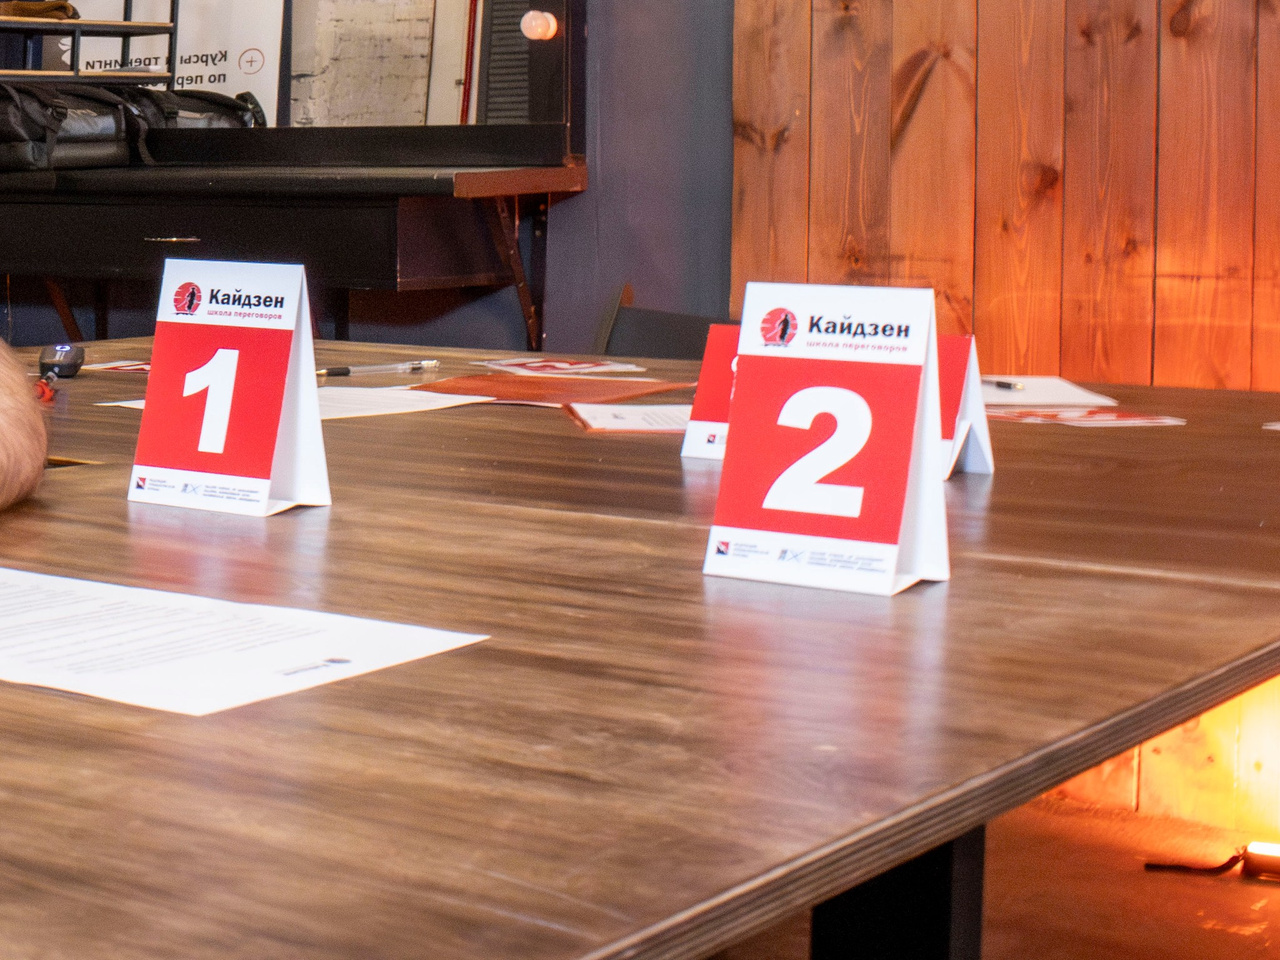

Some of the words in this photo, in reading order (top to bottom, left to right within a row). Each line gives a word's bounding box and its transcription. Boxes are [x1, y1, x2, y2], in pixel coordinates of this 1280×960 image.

[209, 288, 285, 310] Кайдзен
[207, 309, 232, 317] школа
[234, 311, 283, 320] переговоров
[808, 314, 910, 339] Кайдзен
[182, 348, 240, 454] 1
[761, 385, 873, 518] 2
